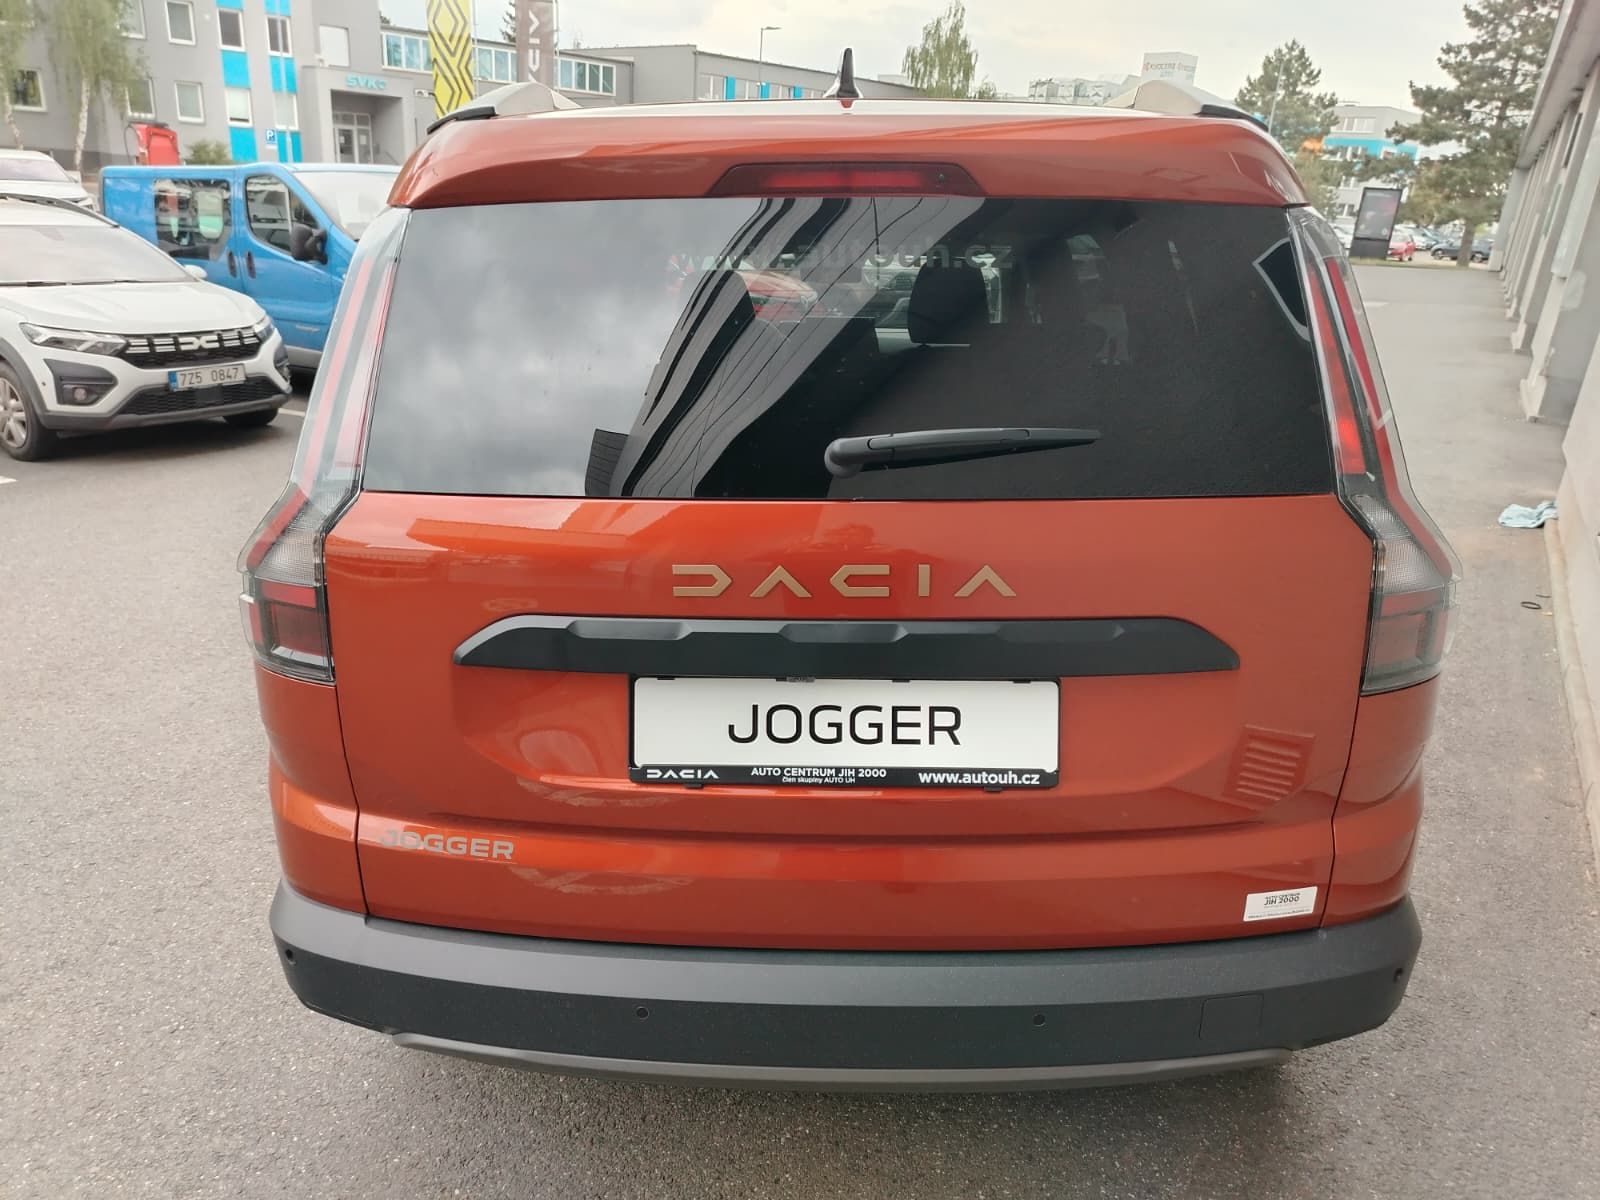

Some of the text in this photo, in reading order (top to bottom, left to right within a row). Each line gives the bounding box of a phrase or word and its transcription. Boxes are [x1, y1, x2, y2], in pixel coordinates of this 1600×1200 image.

[180, 367, 239, 387] 7Z5 0847
[671, 563, 1017, 598] DACIA
[728, 704, 961, 746] JOGGER
[646, 769, 719, 780] DACIA
[750, 767, 887, 778] AUTO CENTRUM JIH 2000
[919, 770, 1040, 785] www.autouh.cz
[798, 777, 824, 785] skupiny
[824, 776, 844, 784] AUTO
[382, 829, 515, 860] JOGGER
[1264, 898, 1277, 906] JIH
[1279, 896, 1300, 904] 2000
